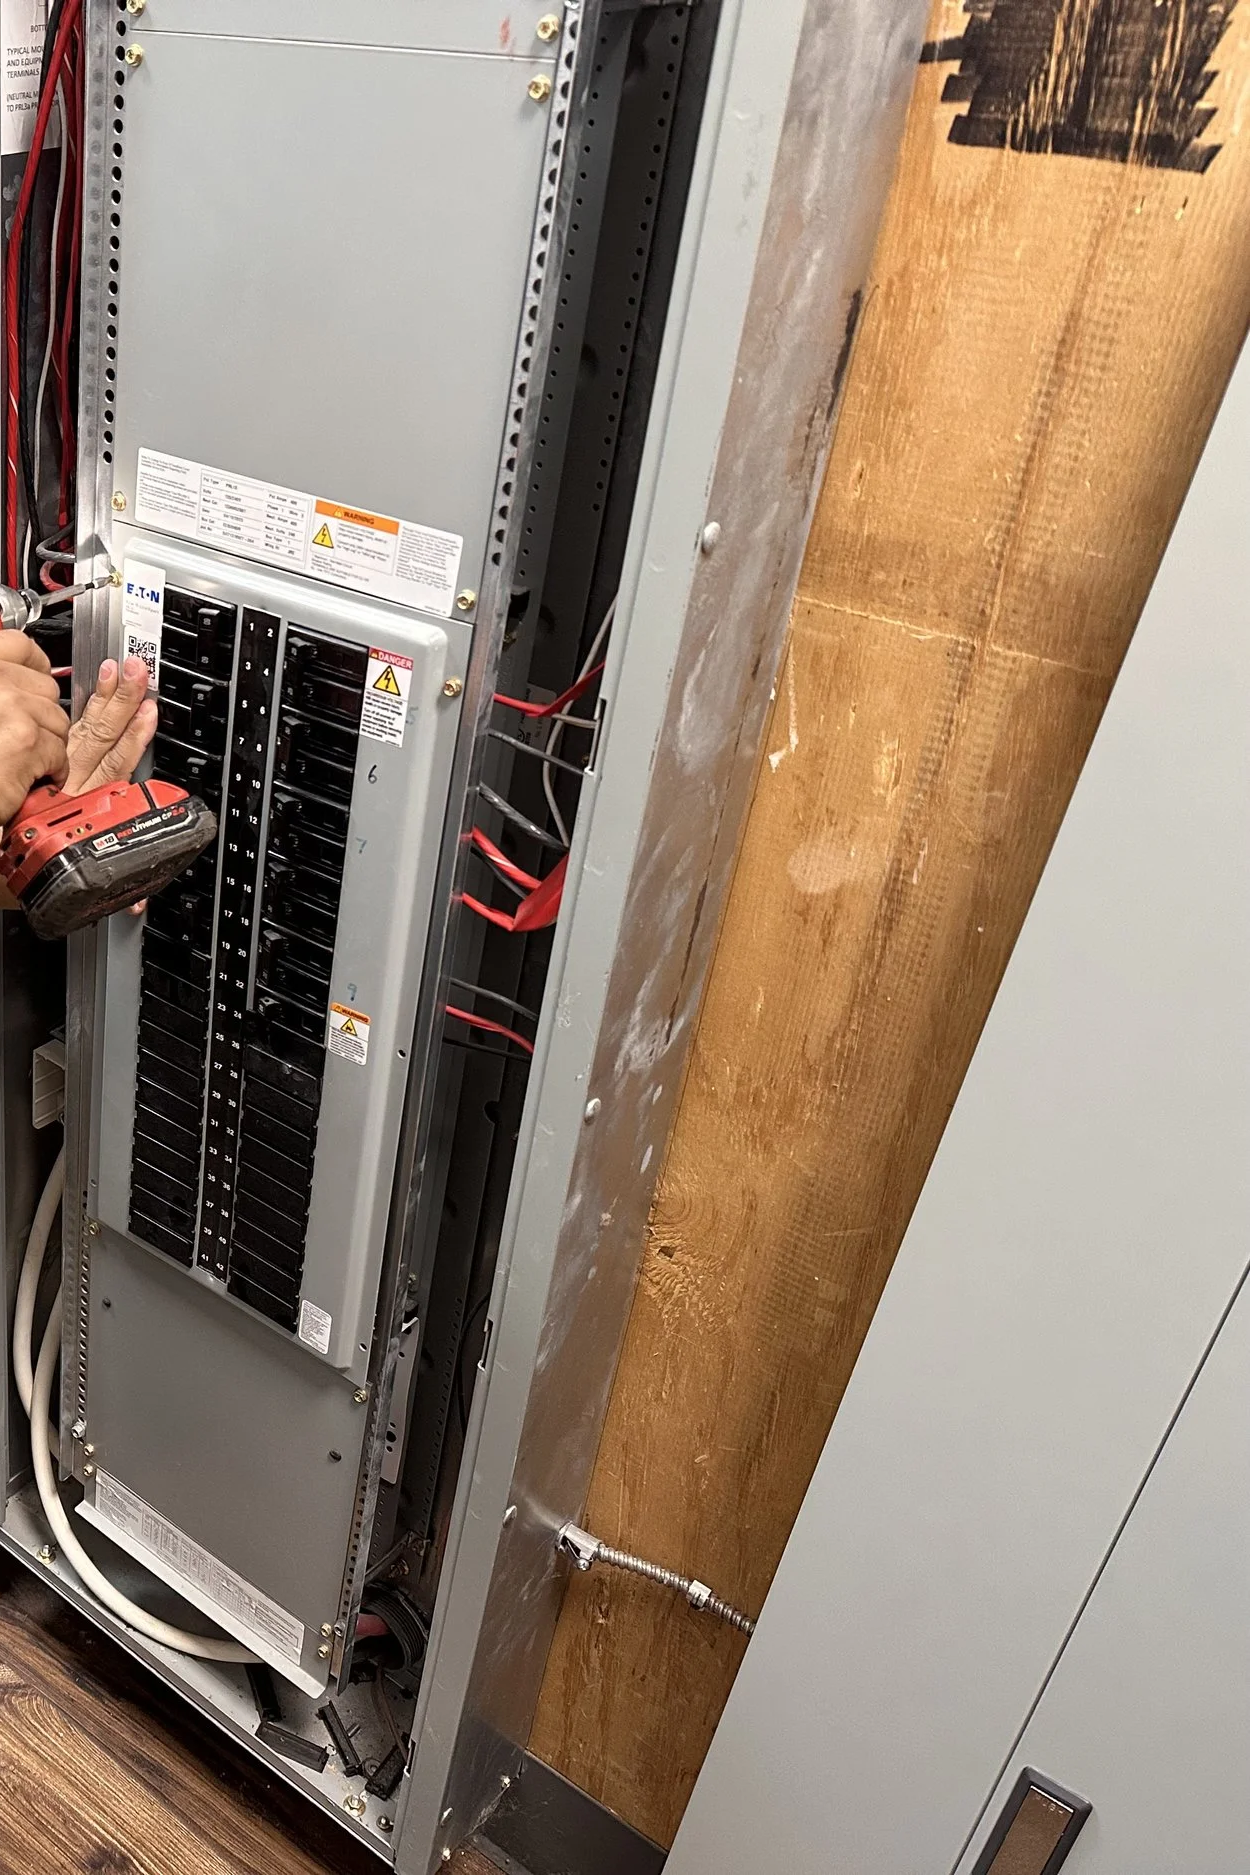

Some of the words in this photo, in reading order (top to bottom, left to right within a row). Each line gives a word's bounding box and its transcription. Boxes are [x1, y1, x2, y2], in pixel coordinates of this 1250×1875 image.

[30, 24, 47, 33] BOTT
[6, 46, 29, 56] TYPICAL
[6, 59, 20, 67] AND
[6, 68, 39, 78] TERMINALS
[6, 104, 14, 112] TO
[343, 511, 375, 525] WARNING
[378, 652, 413, 669] DANGER
[367, 764, 378, 784] 6
[251, 779, 261, 789] 10
[231, 808, 240, 817] 11
[248, 815, 258, 825] 12
[96, 835, 115, 848] M18
[229, 843, 238, 852] 13
[245, 849, 255, 860] 14
[226, 876, 235, 886] 15
[243, 884, 252, 893] 16
[224, 909, 233, 918] 17
[240, 916, 250, 927] 18
[221, 941, 231, 950] 19
[237, 948, 247, 958] 20
[219, 972, 228, 981] 21
[235, 979, 245, 989] 22
[217, 1002, 226, 1012] 23
[233, 1010, 242, 1020] 24
[215, 1032, 225, 1042] 25
[231, 1040, 240, 1050] 26
[213, 1061, 223, 1070] 27
[229, 1069, 238, 1079] 28
[212, 1090, 221, 1100] 29
[228, 1098, 237, 1108] 30
[210, 1118, 219, 1127] 31
[226, 1126, 235, 1136] 32
[209, 1146, 218, 1155] 33
[224, 1154, 233, 1164] 34
[207, 1173, 216, 1182] 35
[222, 1182, 231, 1191] 36
[205, 1200, 215, 1209] 37
[221, 1208, 229, 1218] 38
[203, 1226, 213, 1236] 39
[218, 1236, 227, 1245] 40
[201, 1253, 209, 1262] 41
[216, 1262, 224, 1272] 42
